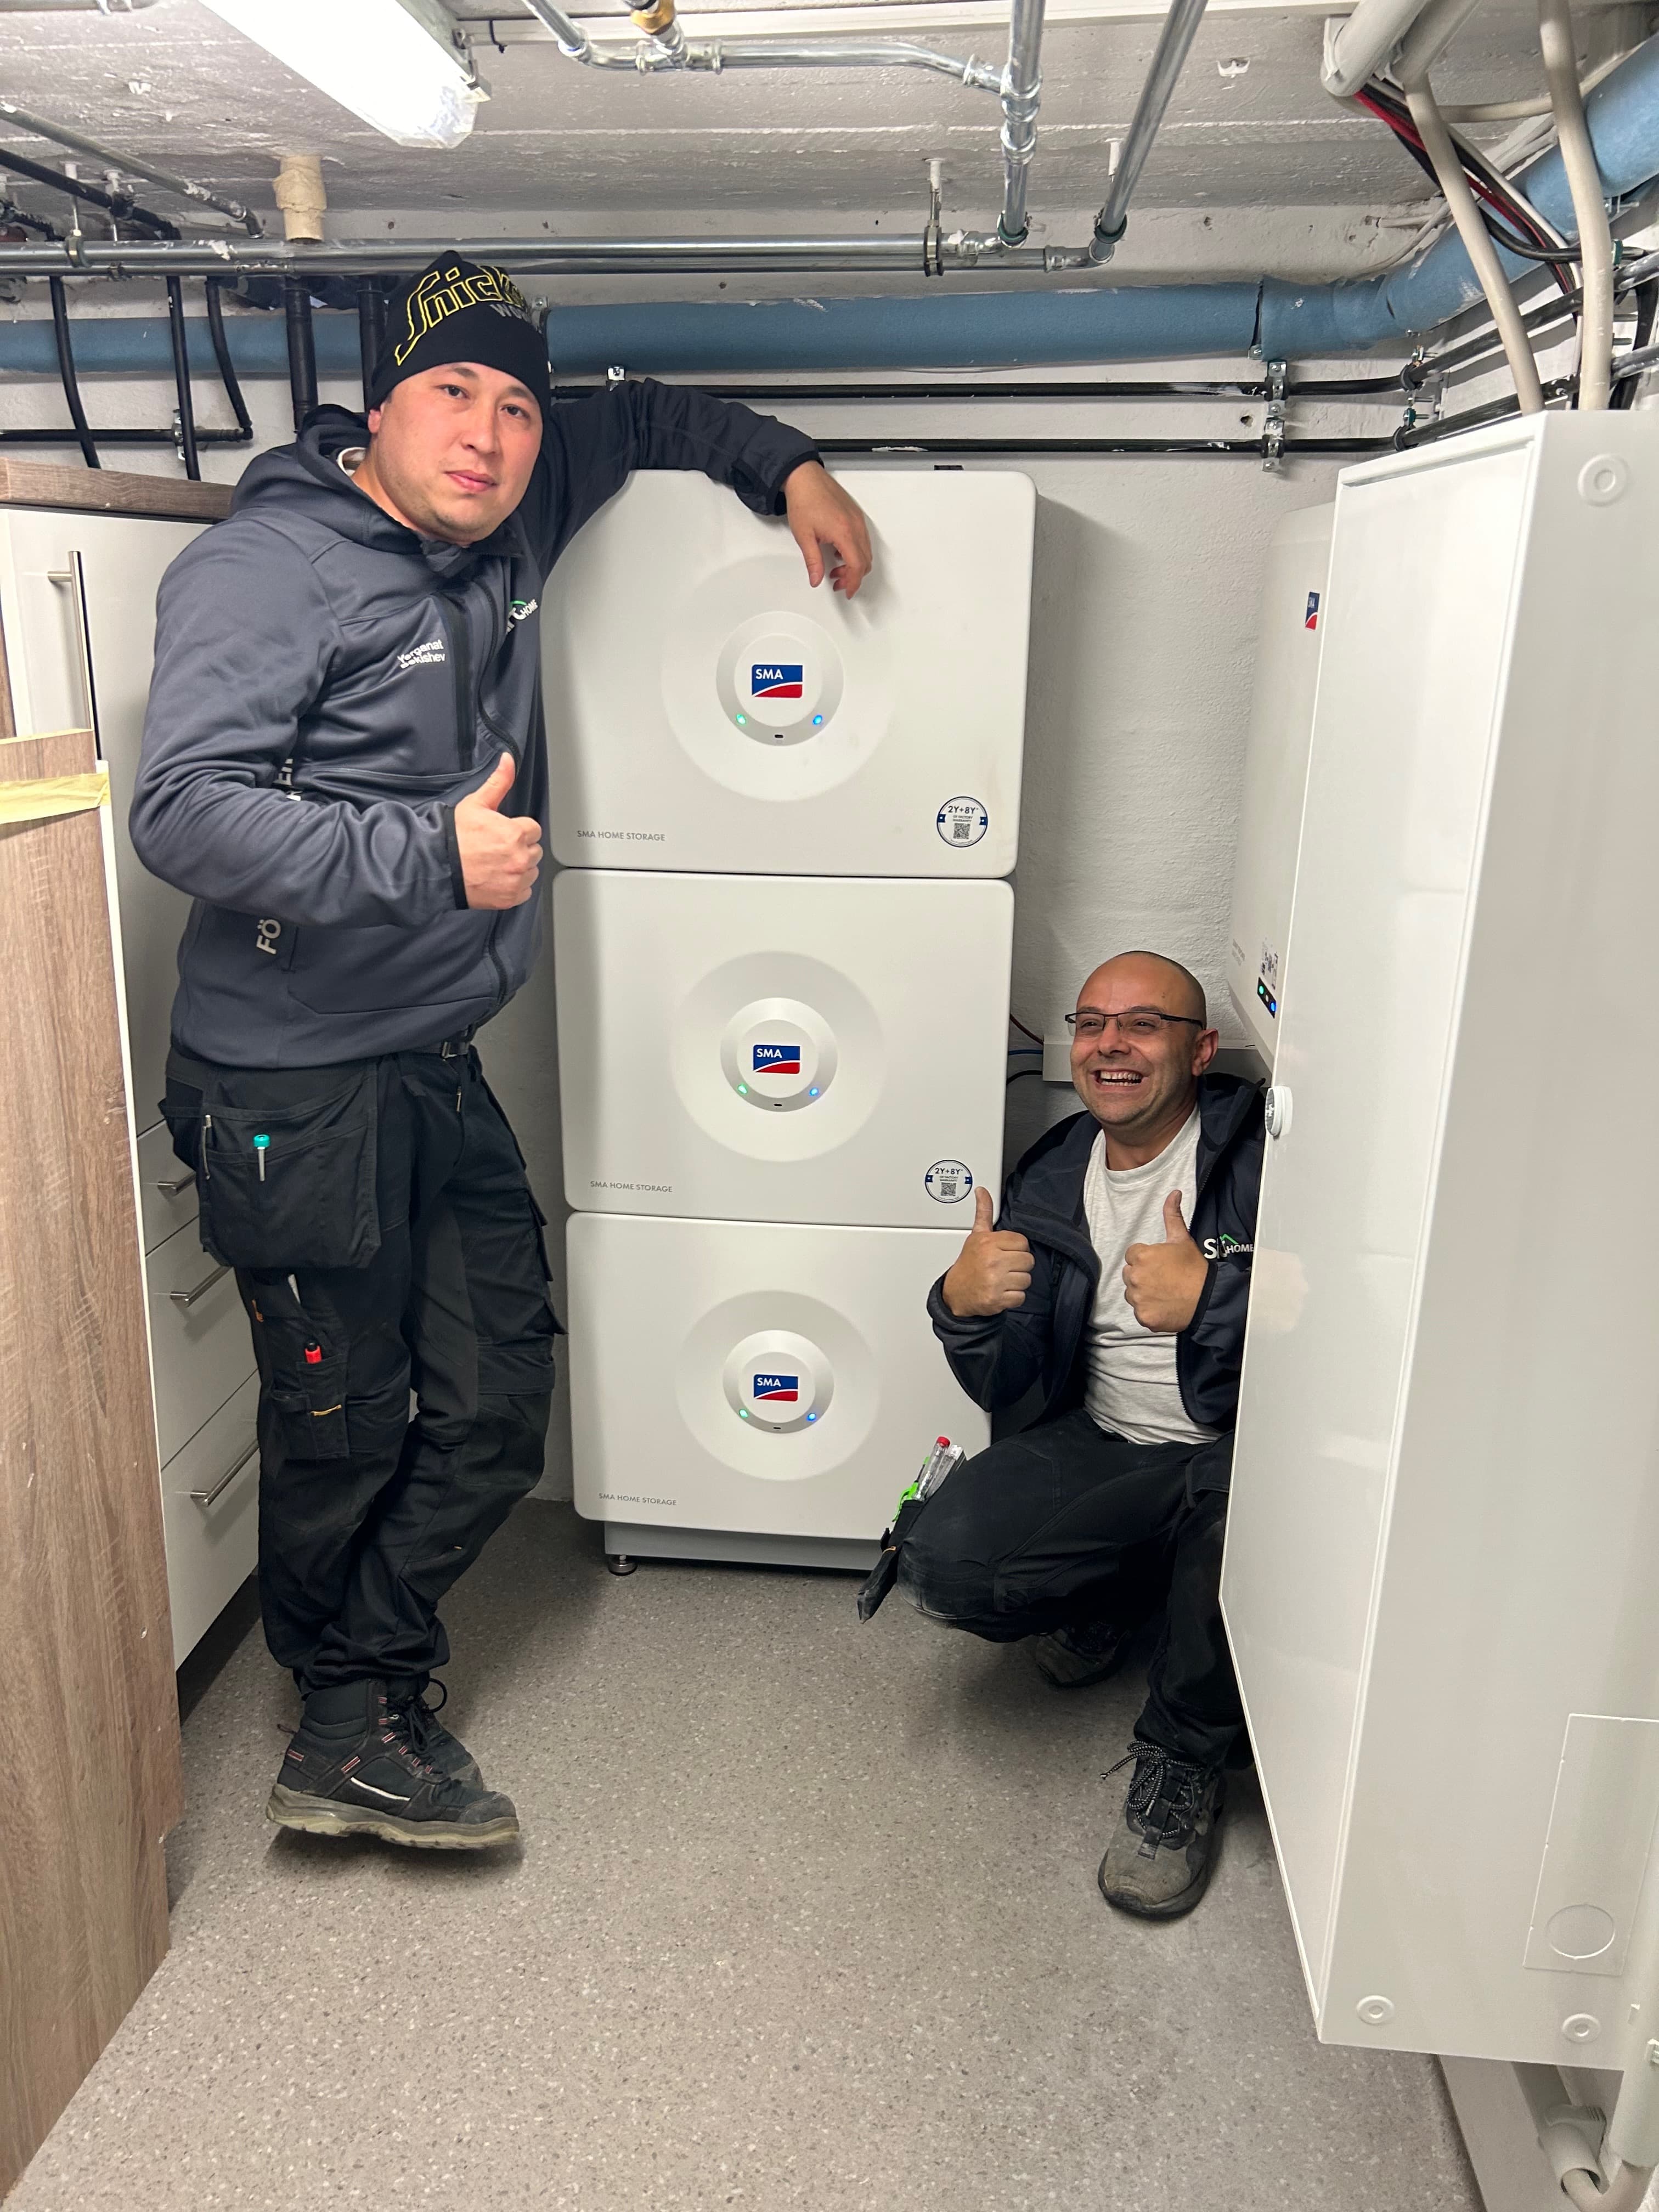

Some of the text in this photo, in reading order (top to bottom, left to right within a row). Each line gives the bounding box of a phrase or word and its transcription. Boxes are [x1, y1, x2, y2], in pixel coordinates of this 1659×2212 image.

[755, 668, 783, 680] SMA
[598, 831, 624, 839] HOME
[627, 832, 665, 841] STORAGE
[757, 1048, 782, 1058] SMA
[636, 1184, 673, 1192] STORAGE
[1226, 1244, 1254, 1254] HOME
[757, 1377, 781, 1387] SMA
[642, 1497, 677, 1505] STORAGE
